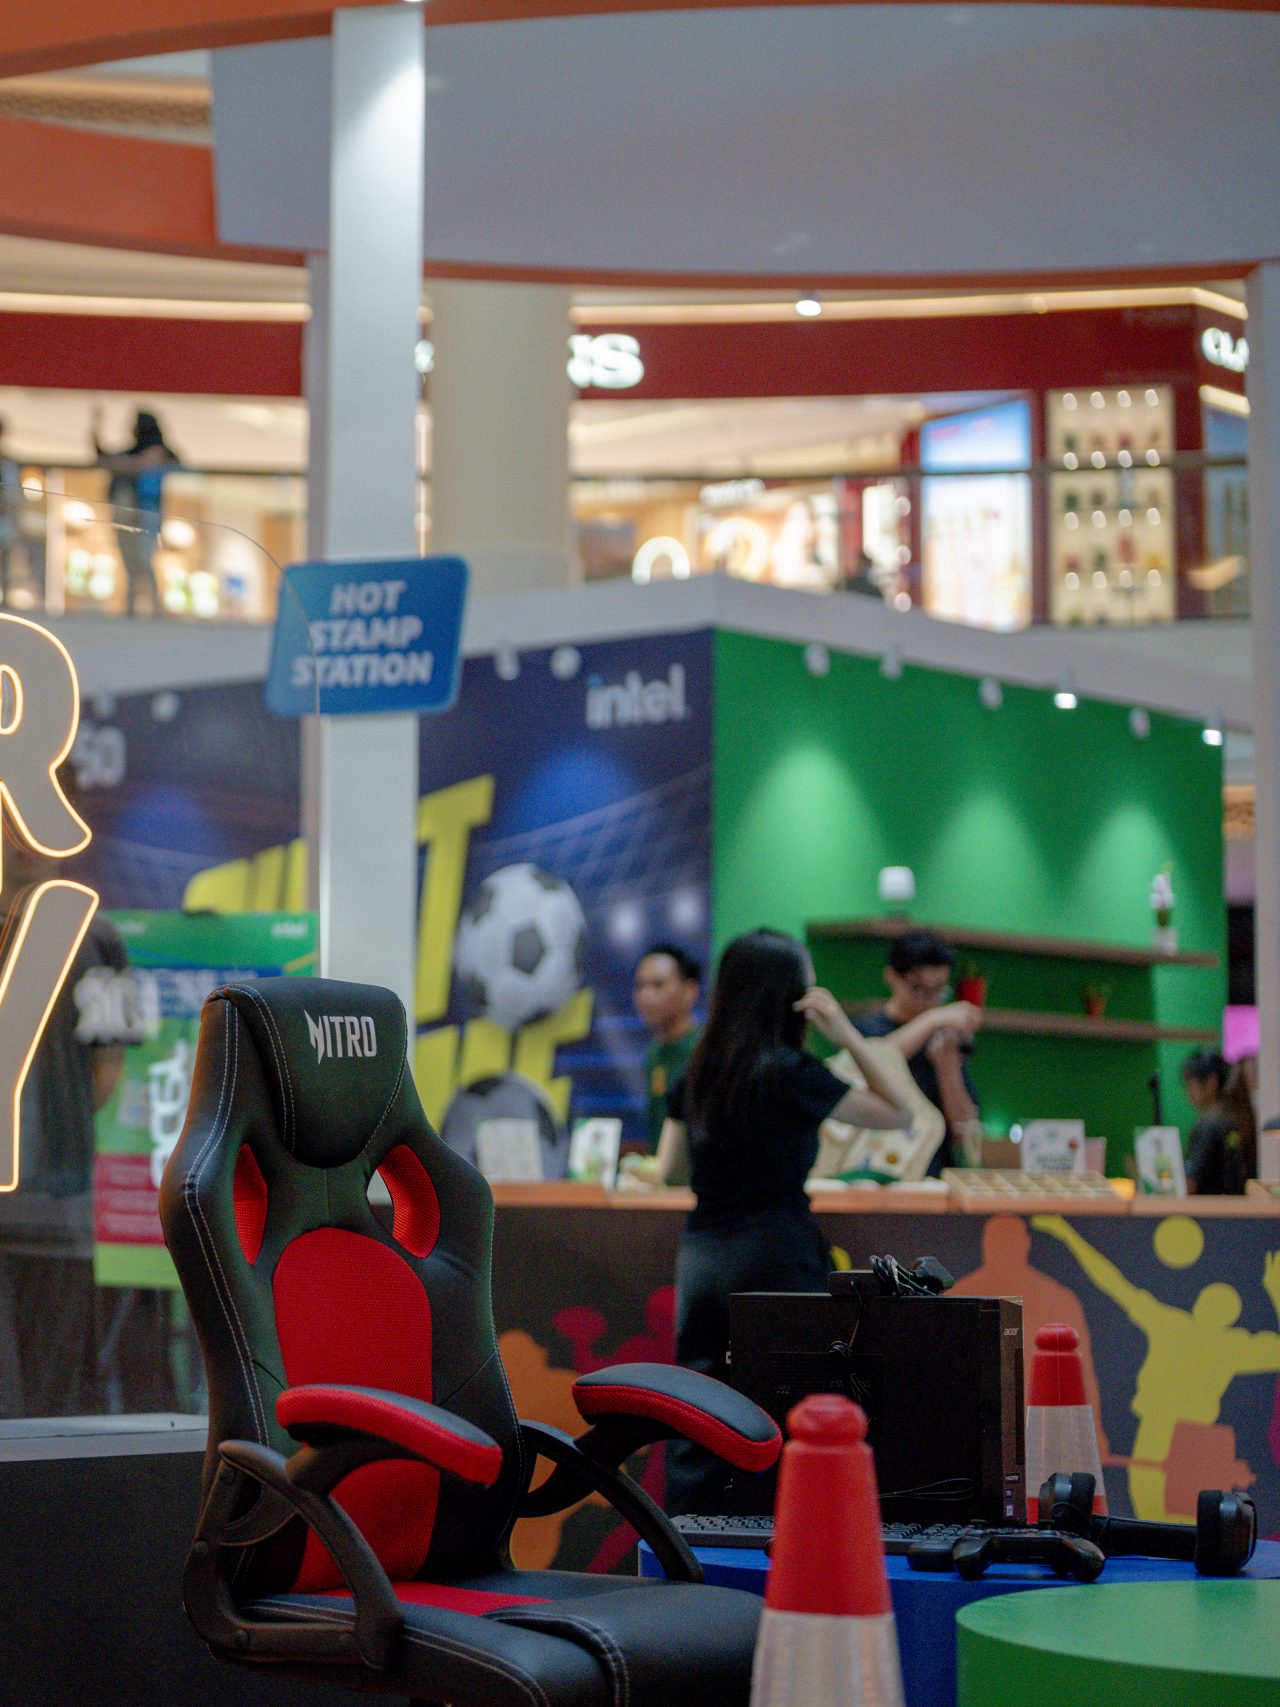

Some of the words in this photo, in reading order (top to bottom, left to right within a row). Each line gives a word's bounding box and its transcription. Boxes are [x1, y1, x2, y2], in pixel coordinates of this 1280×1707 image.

[329, 579, 406, 615] HOT
[307, 615, 424, 651] STAMP
[290, 651, 434, 688] STATION
[586, 663, 686, 729] intel
[304, 1009, 377, 1064] NITRO
[1004, 1327, 1019, 1335] acer
